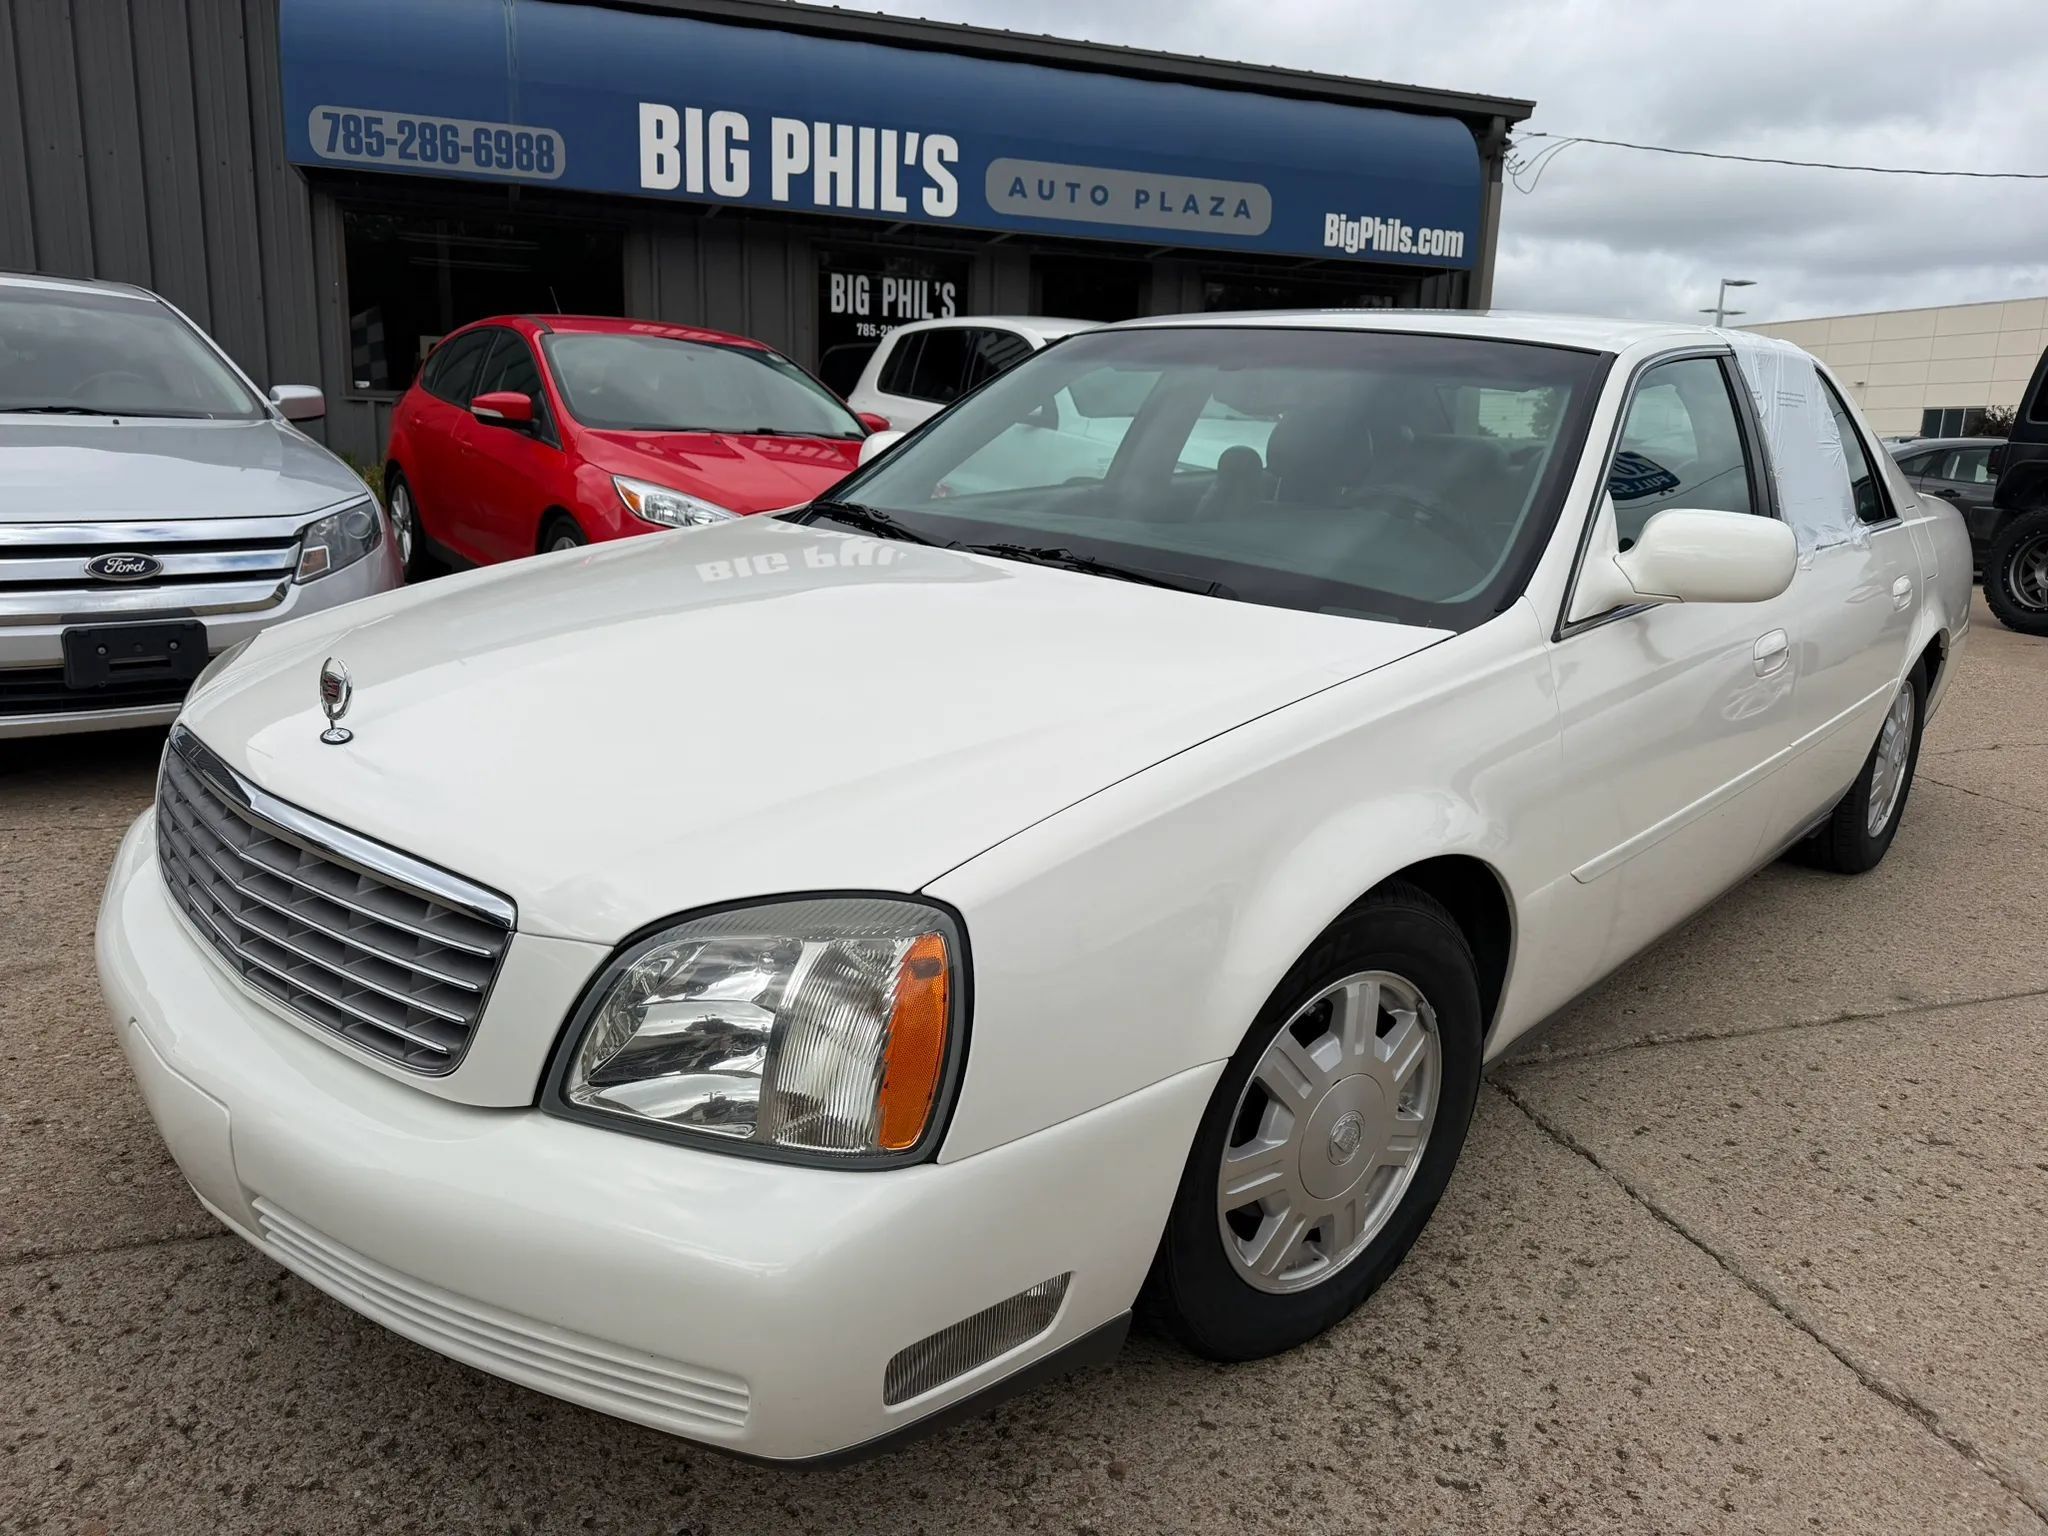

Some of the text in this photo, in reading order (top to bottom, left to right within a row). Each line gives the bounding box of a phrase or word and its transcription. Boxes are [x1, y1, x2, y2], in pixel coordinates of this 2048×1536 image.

[322, 112, 555, 173] 785-286-6988
[639, 102, 959, 218] BIG PHIL'S
[1008, 176, 1251, 220] AUTO PLAZA
[1324, 213, 1464, 258] BigPhils.com
[830, 273, 956, 319] BIG PHIL'S
[856, 322, 900, 337] 785-2
[104, 557, 146, 574] Ford
